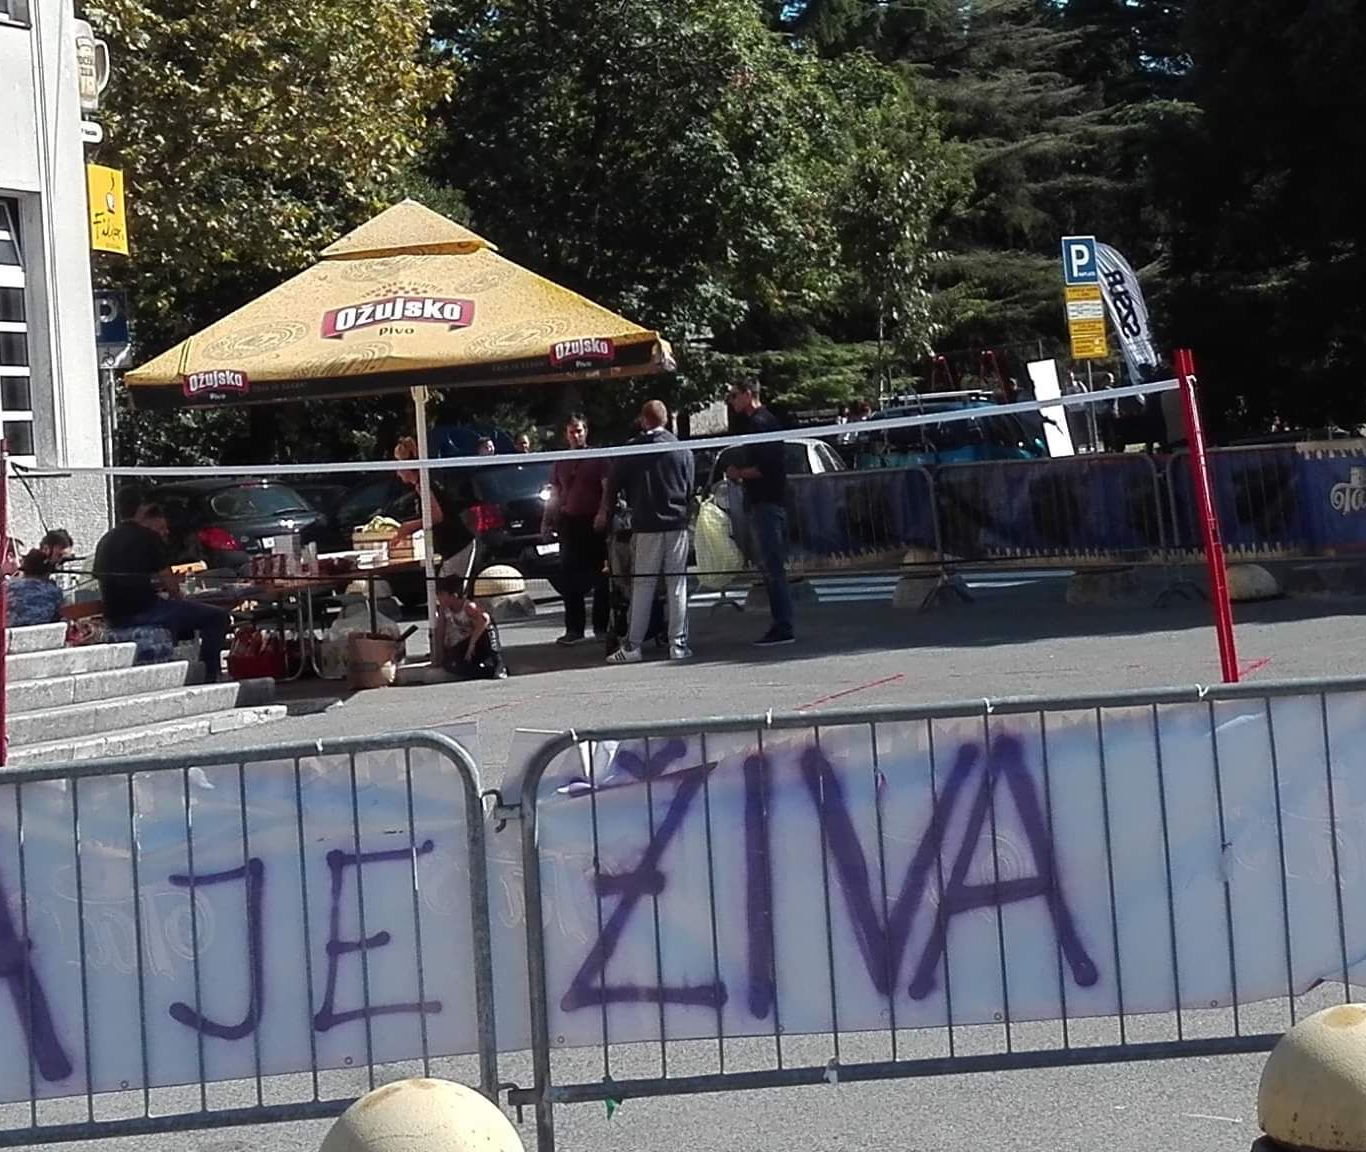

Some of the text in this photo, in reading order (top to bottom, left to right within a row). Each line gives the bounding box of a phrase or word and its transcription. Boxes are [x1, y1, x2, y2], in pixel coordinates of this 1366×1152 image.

[1070, 244, 1089, 278] P
[335, 297, 462, 332] Ožujsko
[168, 839, 443, 1041] JE
[555, 732, 1100, 1018] ŽIVA
